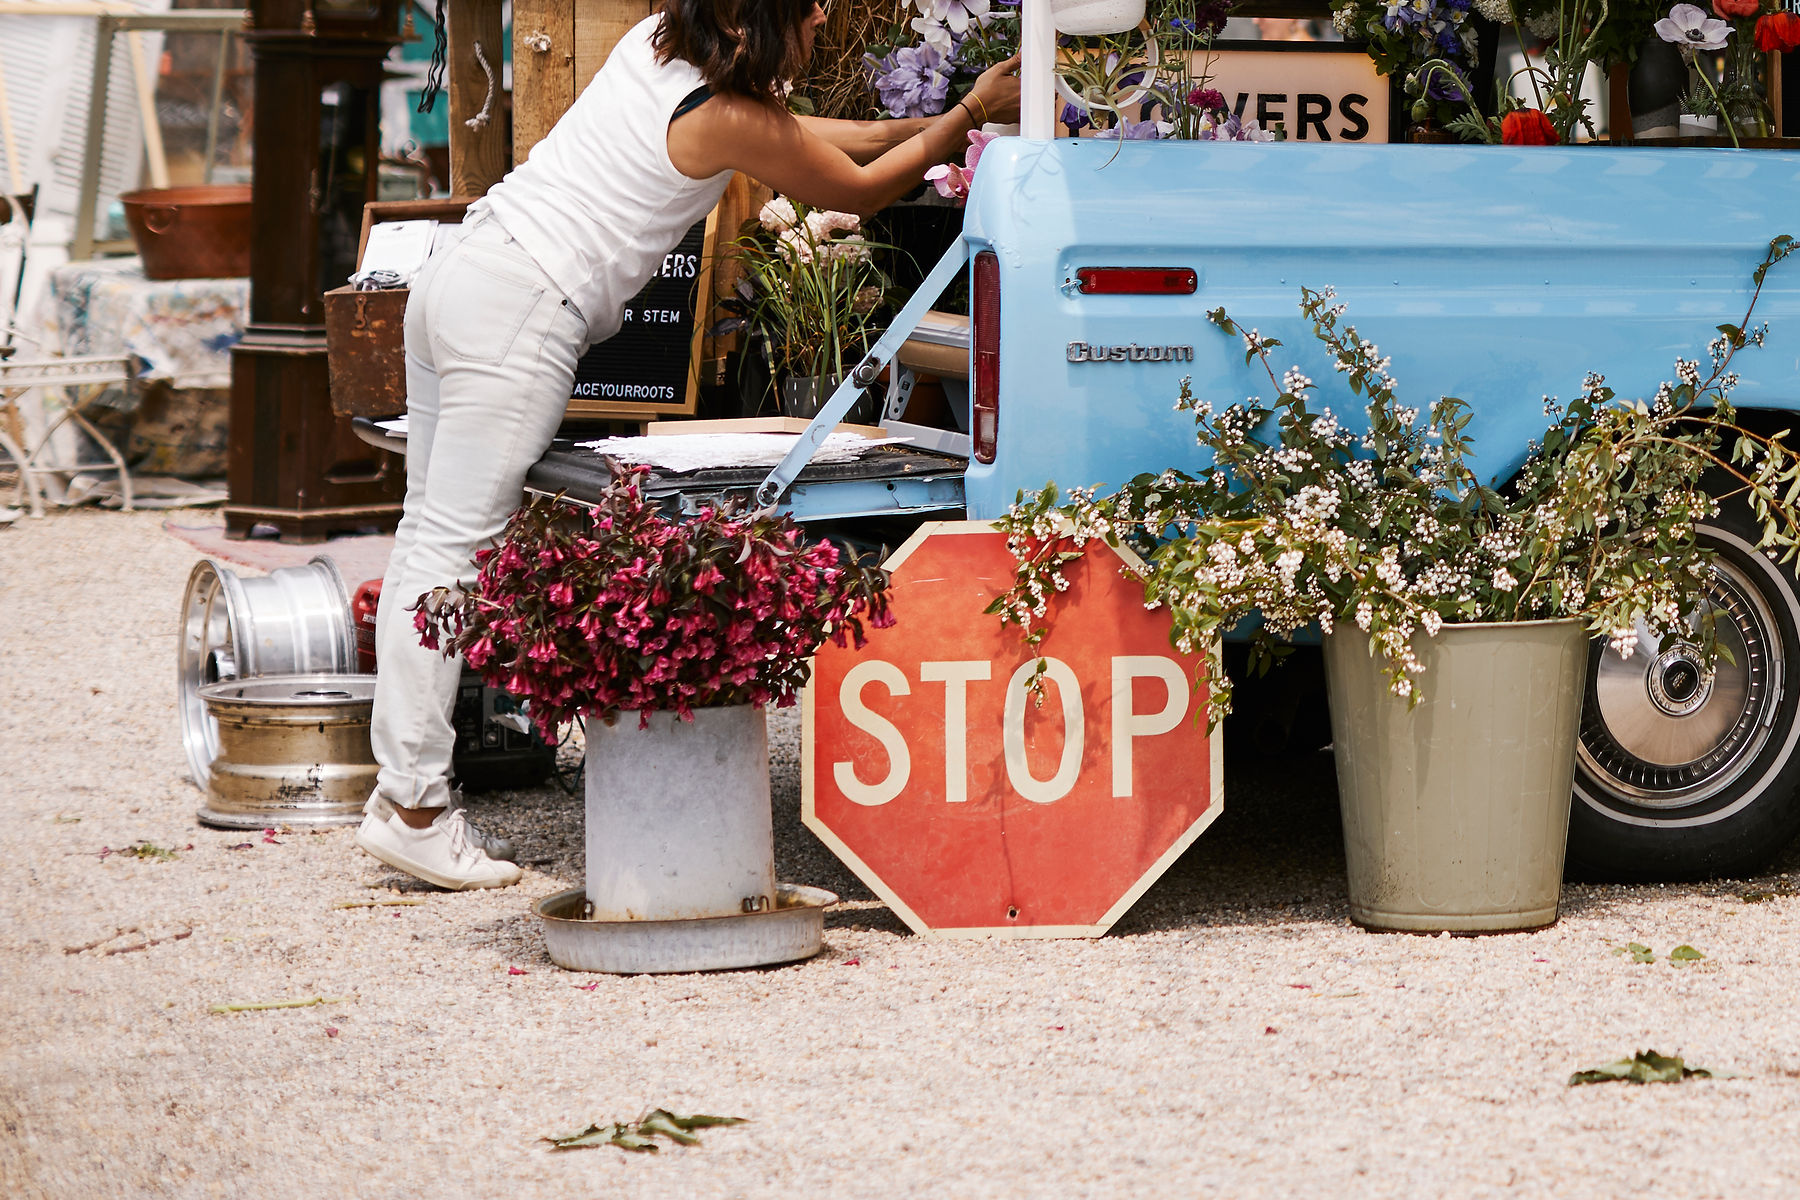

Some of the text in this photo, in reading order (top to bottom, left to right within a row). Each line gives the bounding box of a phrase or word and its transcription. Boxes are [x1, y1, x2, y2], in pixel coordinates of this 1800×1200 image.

[653, 253, 697, 278] ERS
[642, 309, 680, 323] STEM
[1066, 340, 1195, 363] Custom
[572, 382, 674, 399] ACEYOURROOTS
[833, 655, 1190, 807] STOP
